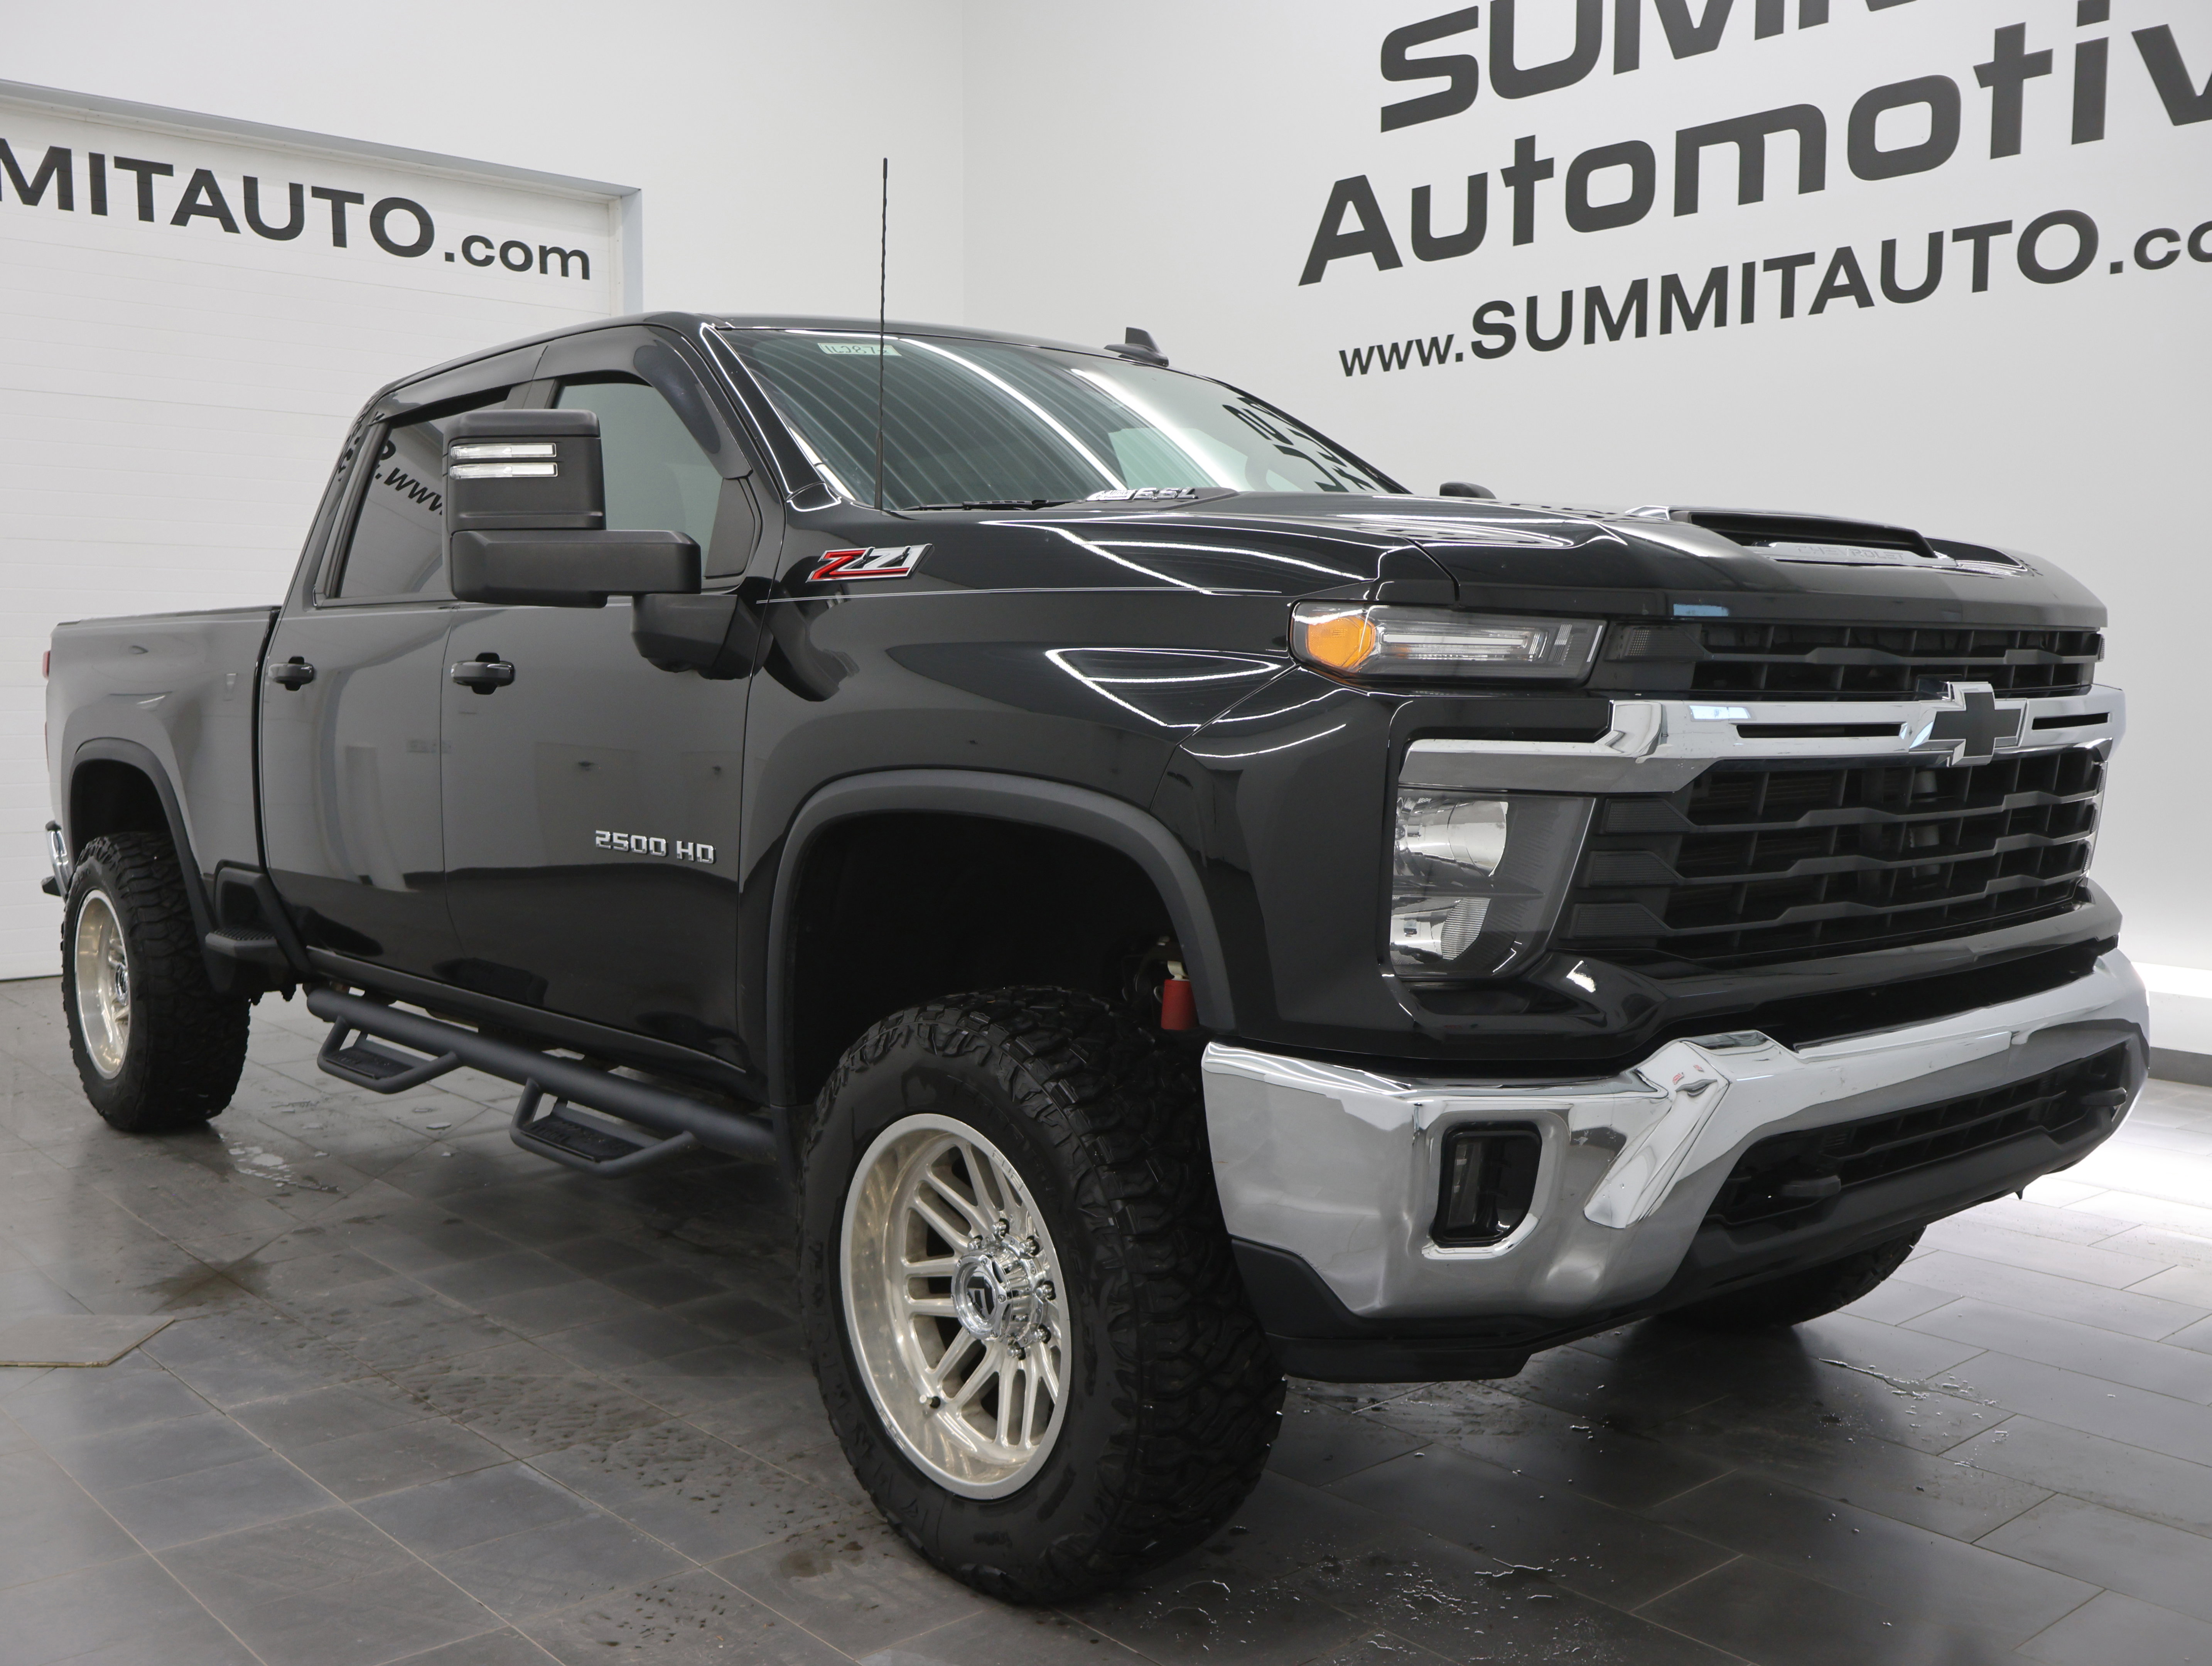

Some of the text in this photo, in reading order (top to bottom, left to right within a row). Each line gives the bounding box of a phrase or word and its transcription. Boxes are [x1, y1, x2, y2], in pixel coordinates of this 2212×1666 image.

[1795, 545, 1904, 560] CHEVROLET
[595, 830, 715, 865] 2500 HD
